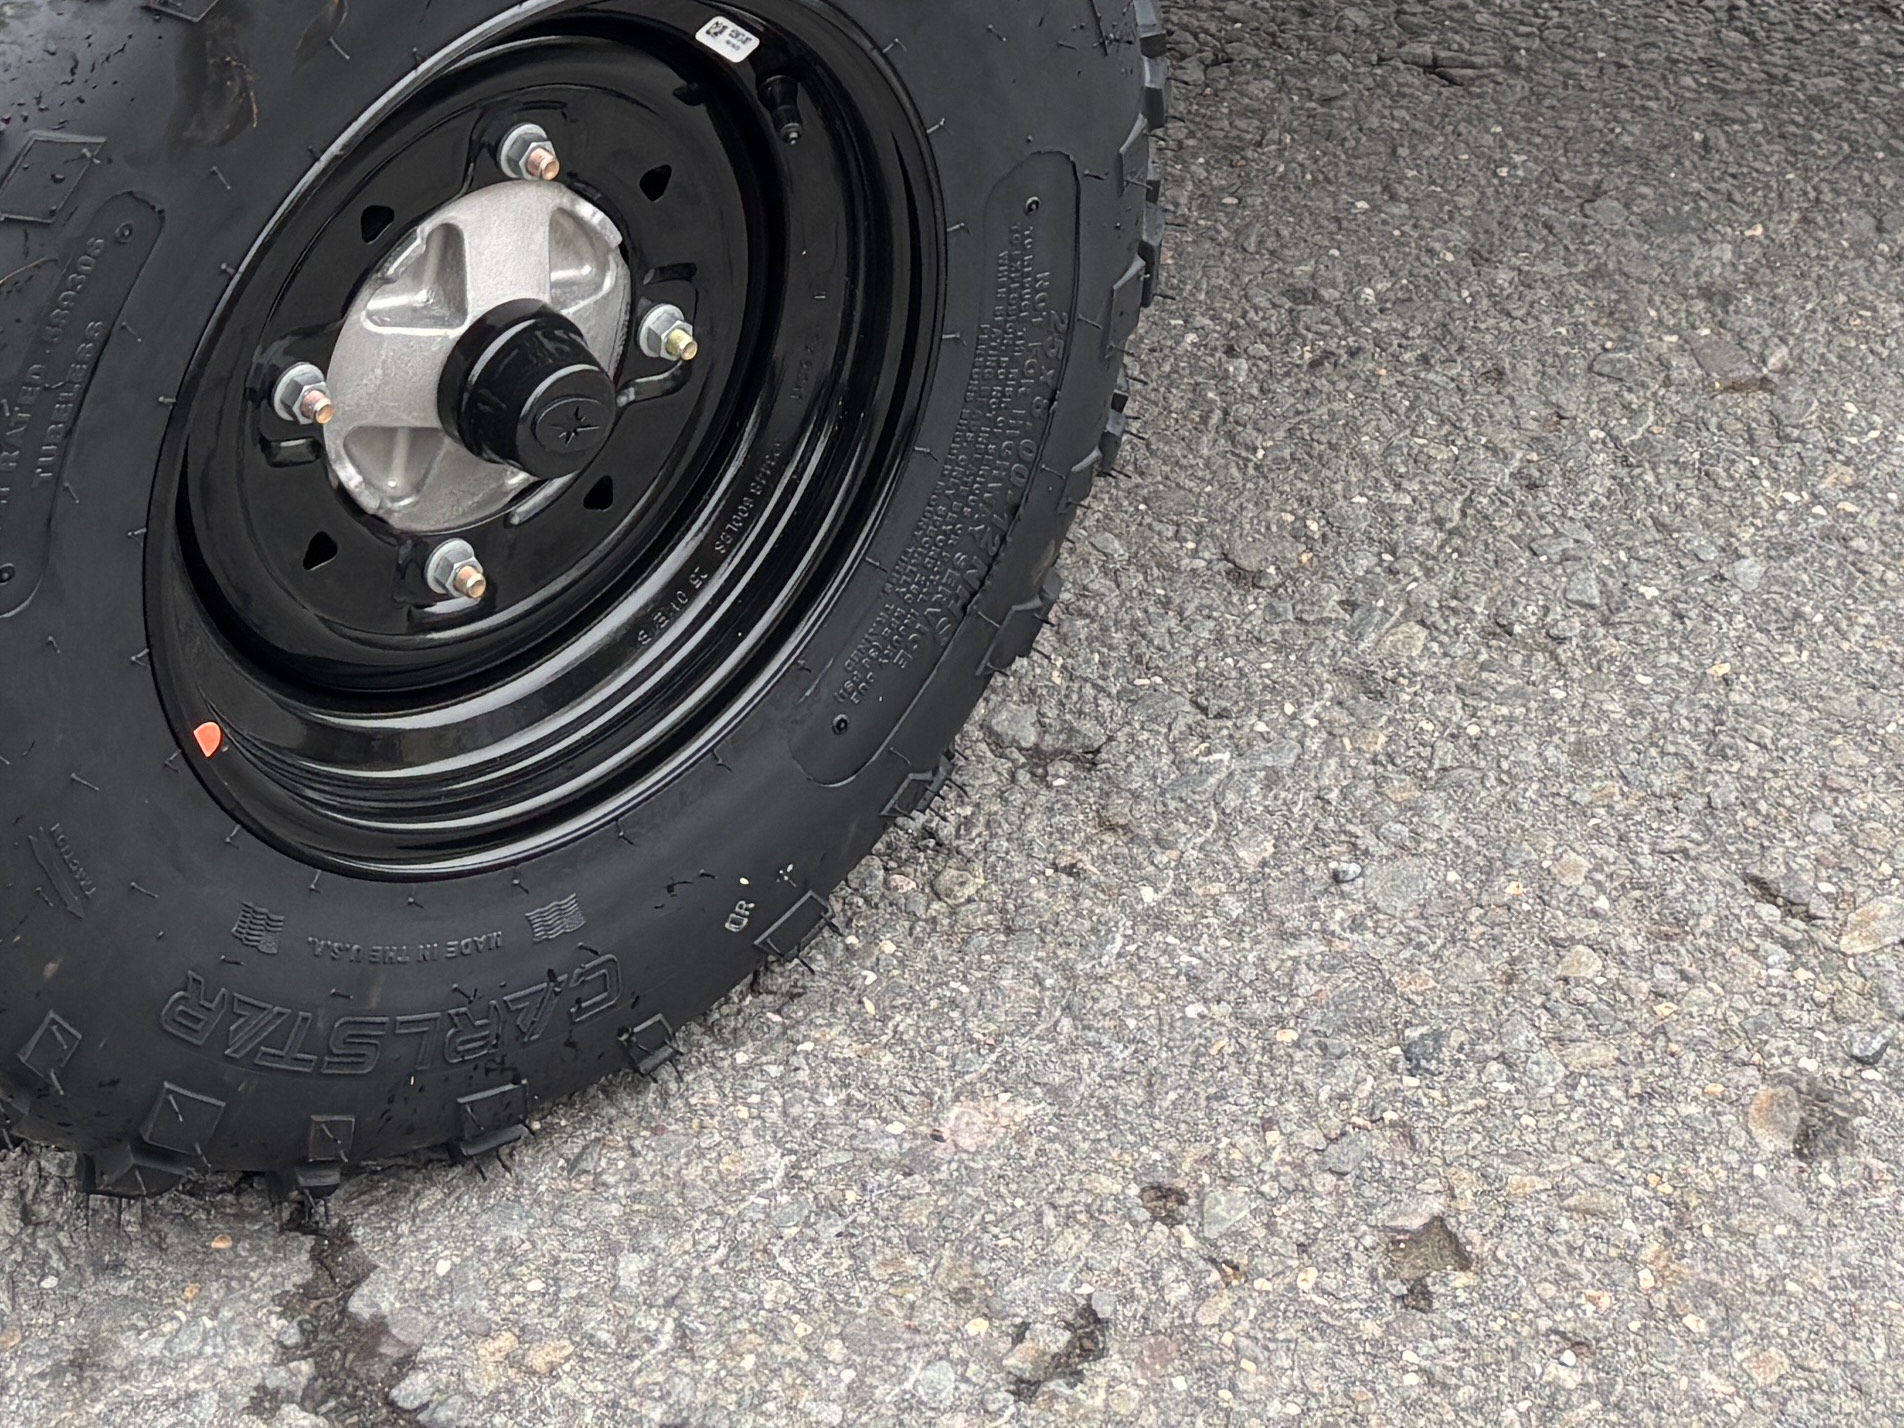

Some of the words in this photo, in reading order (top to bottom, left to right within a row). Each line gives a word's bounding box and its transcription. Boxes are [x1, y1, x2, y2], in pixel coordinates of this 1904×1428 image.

[34, 319, 105, 487] TUBELESS
[895, 550, 967, 671] SERVICE
[363, 944, 413, 967] THE
[413, 941, 441, 965] IN
[442, 926, 504, 962] MADE
[159, 951, 623, 1075] CARLSTAR
